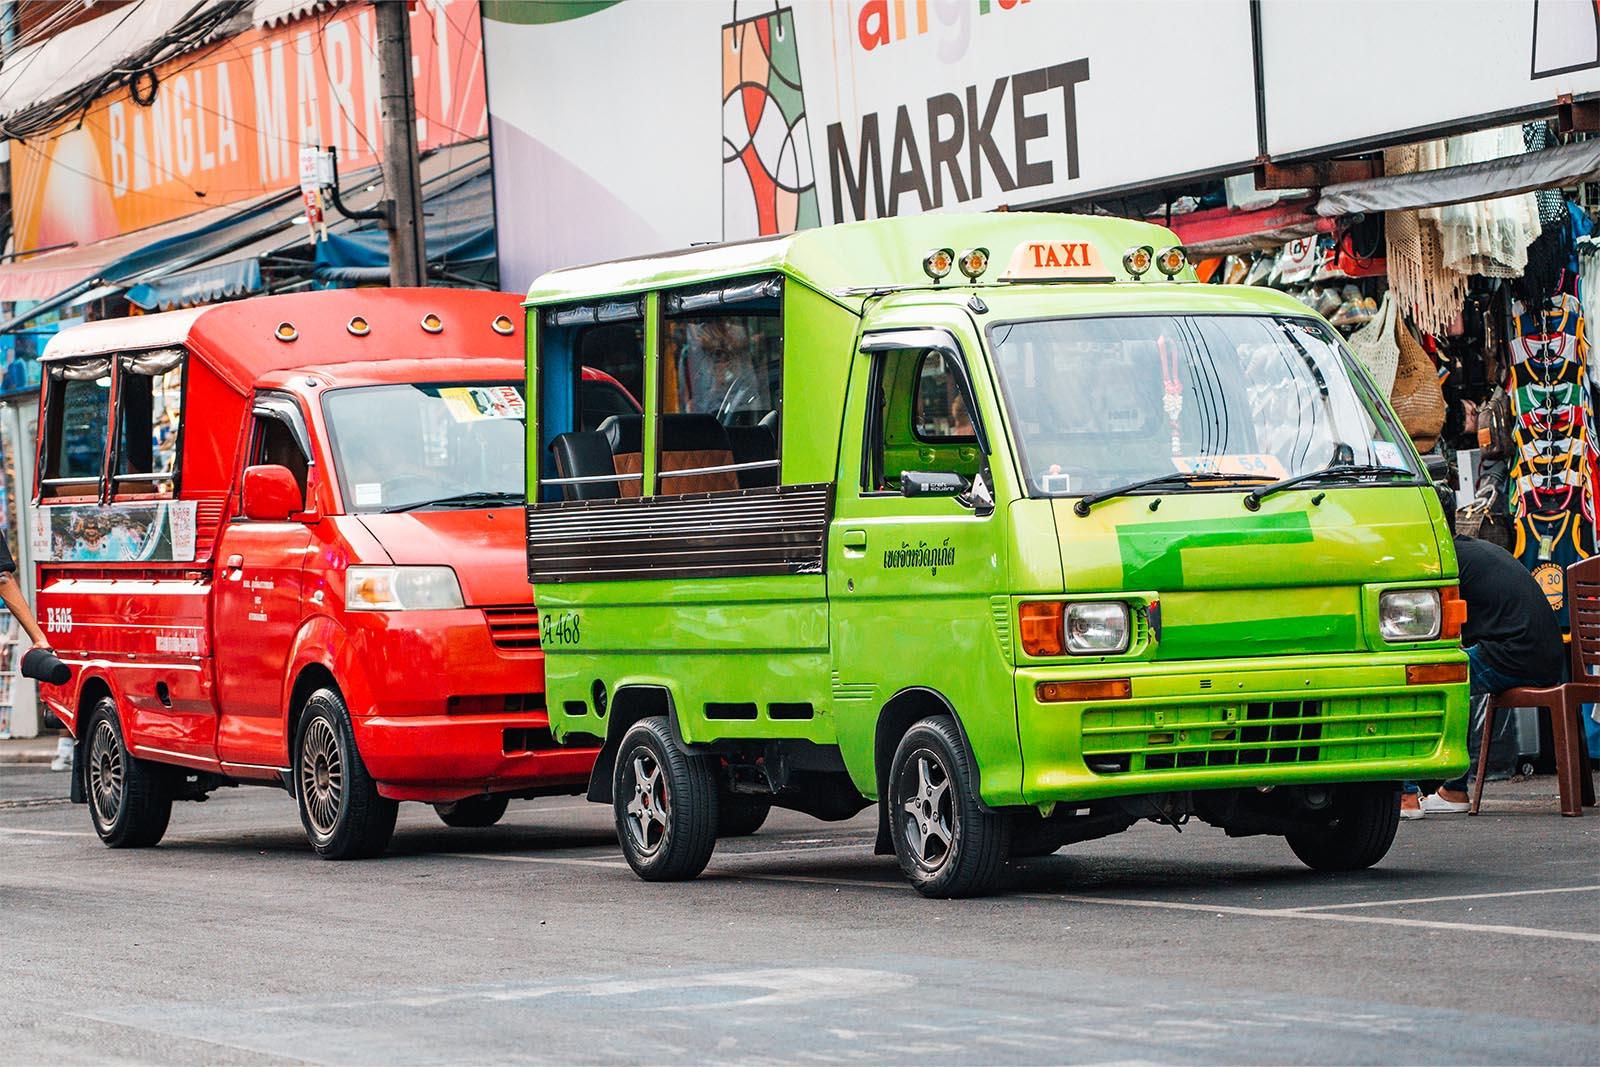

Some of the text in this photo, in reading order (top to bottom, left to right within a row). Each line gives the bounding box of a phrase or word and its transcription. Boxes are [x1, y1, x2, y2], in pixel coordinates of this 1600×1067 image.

[108, 62, 239, 198] BANGLA
[826, 57, 1091, 225] MARKET
[1029, 243, 1091, 267] TAXI
[498, 386, 523, 407] TAXI
[883, 537, 955, 577] เขตจังหวัดภูเก็ต
[1547, 573, 1560, 585] 30
[555, 612, 580, 645] 468
